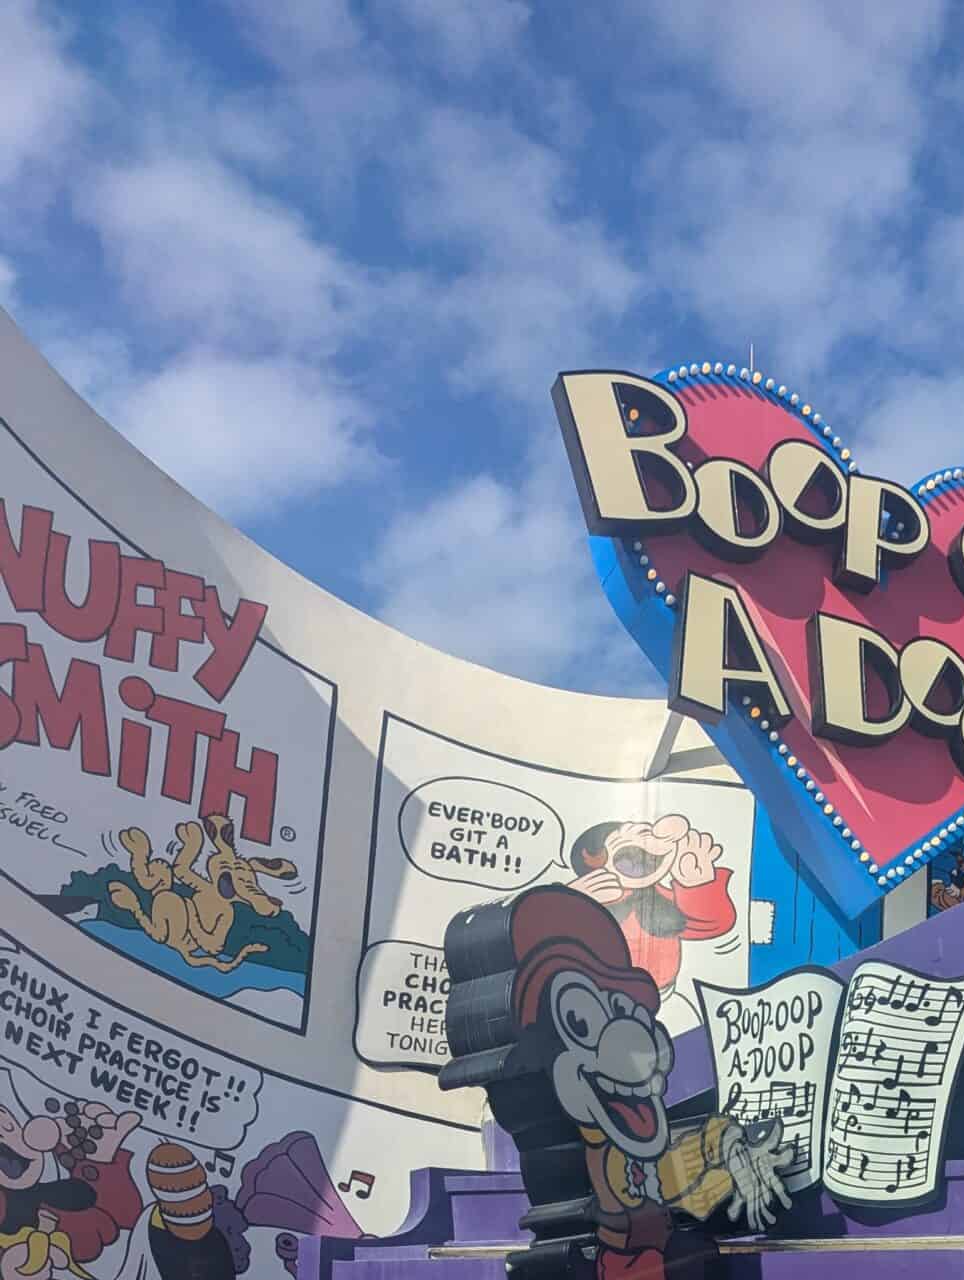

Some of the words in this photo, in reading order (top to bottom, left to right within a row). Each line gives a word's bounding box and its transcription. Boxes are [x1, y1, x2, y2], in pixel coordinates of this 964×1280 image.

[674, 572, 792, 718] A
[16, 791, 68, 823] FRED
[428, 801, 544, 836] EVER'BODY
[450, 827, 487, 845] GIT
[496, 835, 508, 849] A
[410, 952, 449, 973] THA
[405, 973, 451, 995] CHO
[383, 990, 449, 1014] PRAC
[86, 1007, 102, 1030] I
[0, 990, 71, 1042] CHOIR
[78, 1032, 192, 1101] PRACTICE
[200, 1090, 221, 1113] IS
[5, 1020, 83, 1075] NEXT
[386, 1032, 449, 1056] TONIG
